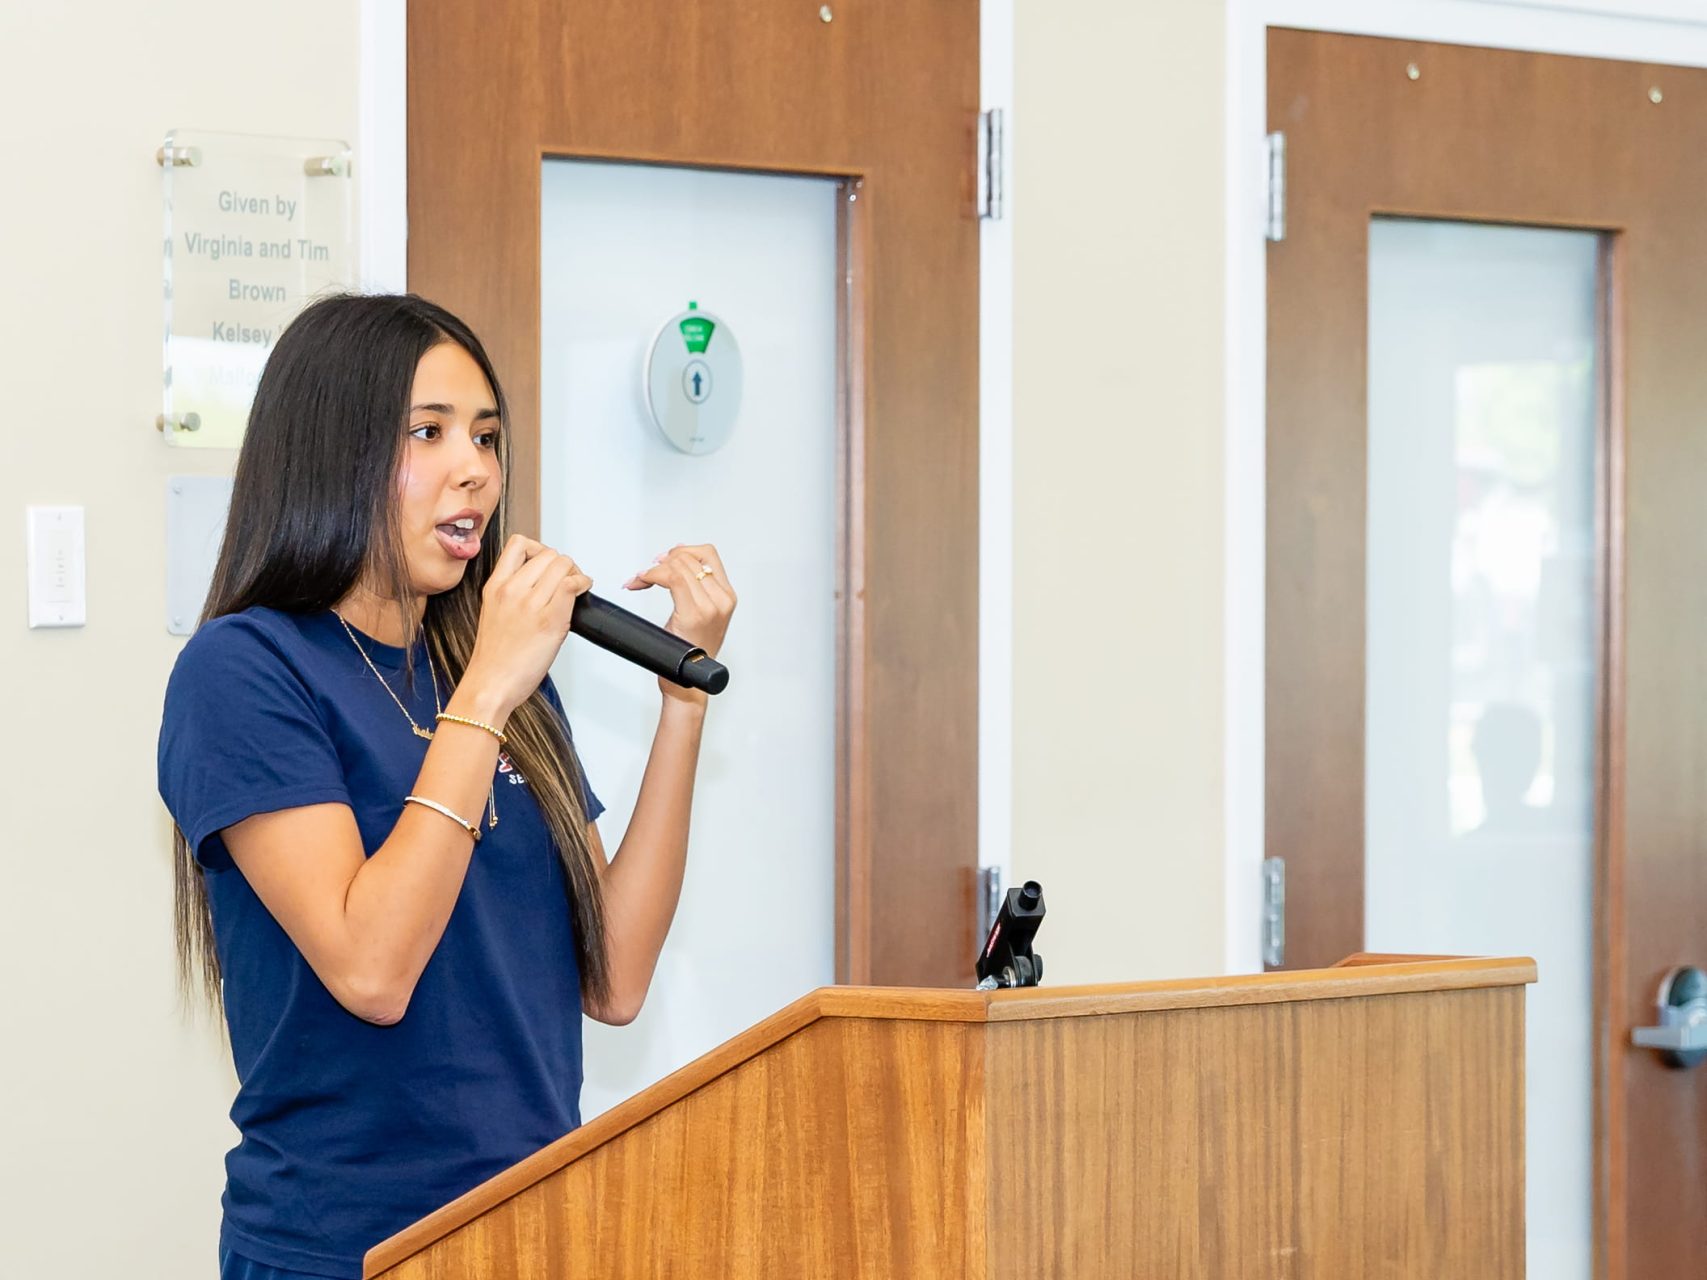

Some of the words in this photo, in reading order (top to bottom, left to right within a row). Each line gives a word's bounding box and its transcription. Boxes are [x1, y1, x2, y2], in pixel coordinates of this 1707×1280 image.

[219, 191, 271, 213] Given
[276, 194, 297, 221] by
[185, 232, 253, 260] Virginia
[260, 239, 291, 258] and
[298, 240, 329, 261] Tim
[229, 279, 286, 301] Brown
[212, 321, 271, 348] Kelsey
